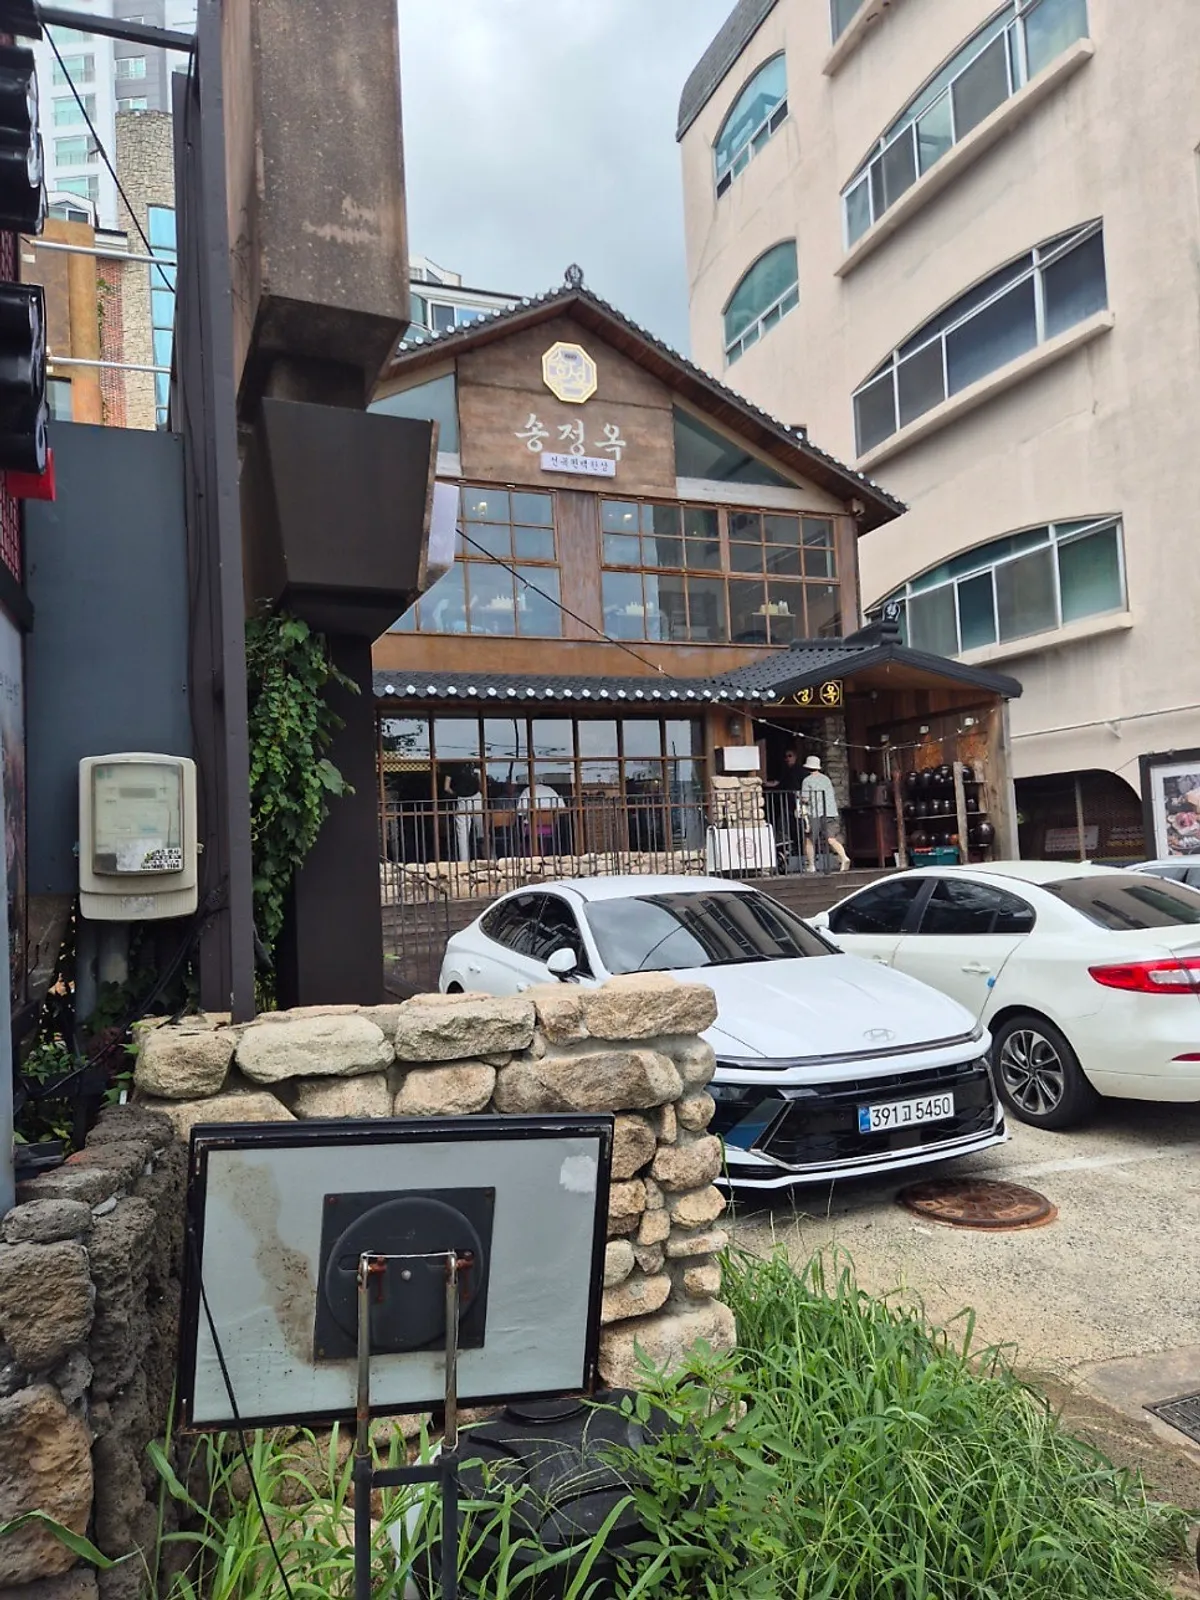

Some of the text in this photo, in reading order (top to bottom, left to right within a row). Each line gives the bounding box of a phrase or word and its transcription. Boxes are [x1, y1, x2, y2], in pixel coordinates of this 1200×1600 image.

[514, 413, 627, 461] 송정옥
[872, 1096, 951, 1127] 391고 5450
